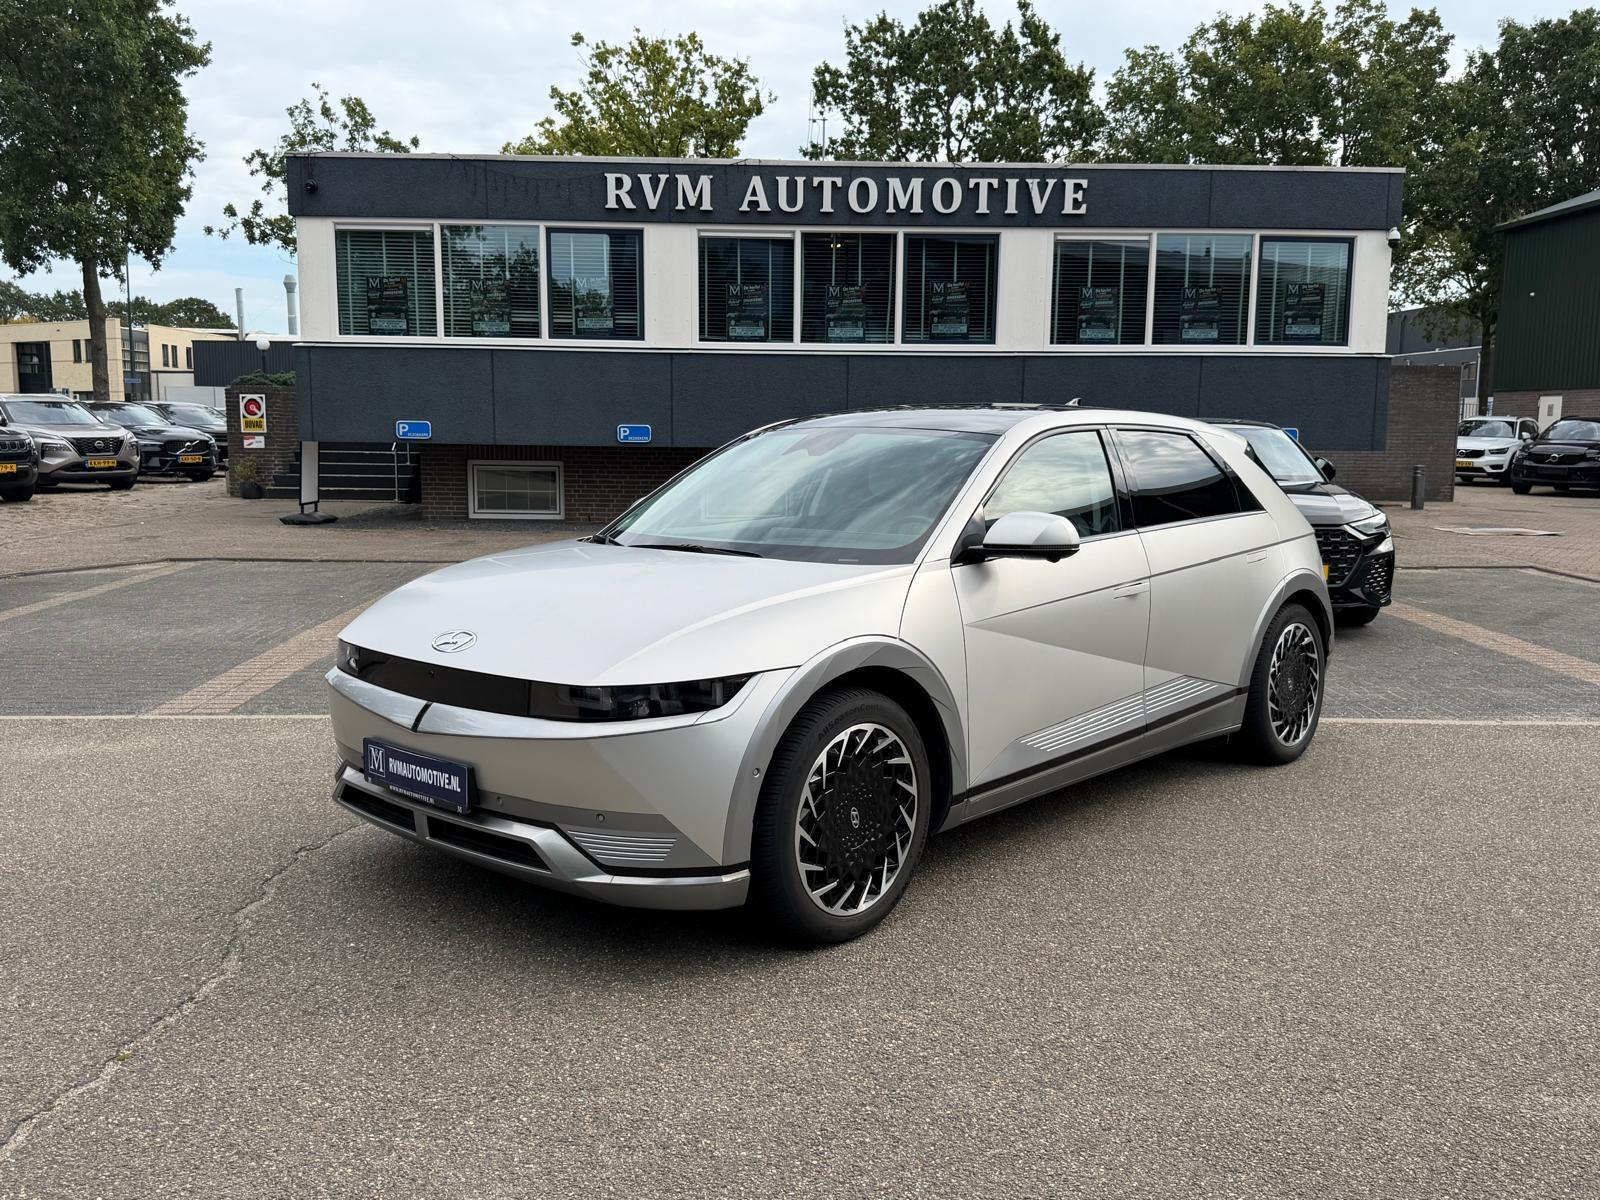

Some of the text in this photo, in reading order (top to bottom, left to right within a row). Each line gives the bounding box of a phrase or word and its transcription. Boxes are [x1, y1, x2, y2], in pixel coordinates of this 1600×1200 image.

[604, 173, 1089, 216] RVM AUTOMOTIVE
[244, 419, 263, 429] BOVAG
[388, 757, 462, 793] RVMAUTOMOTIVE.NL
